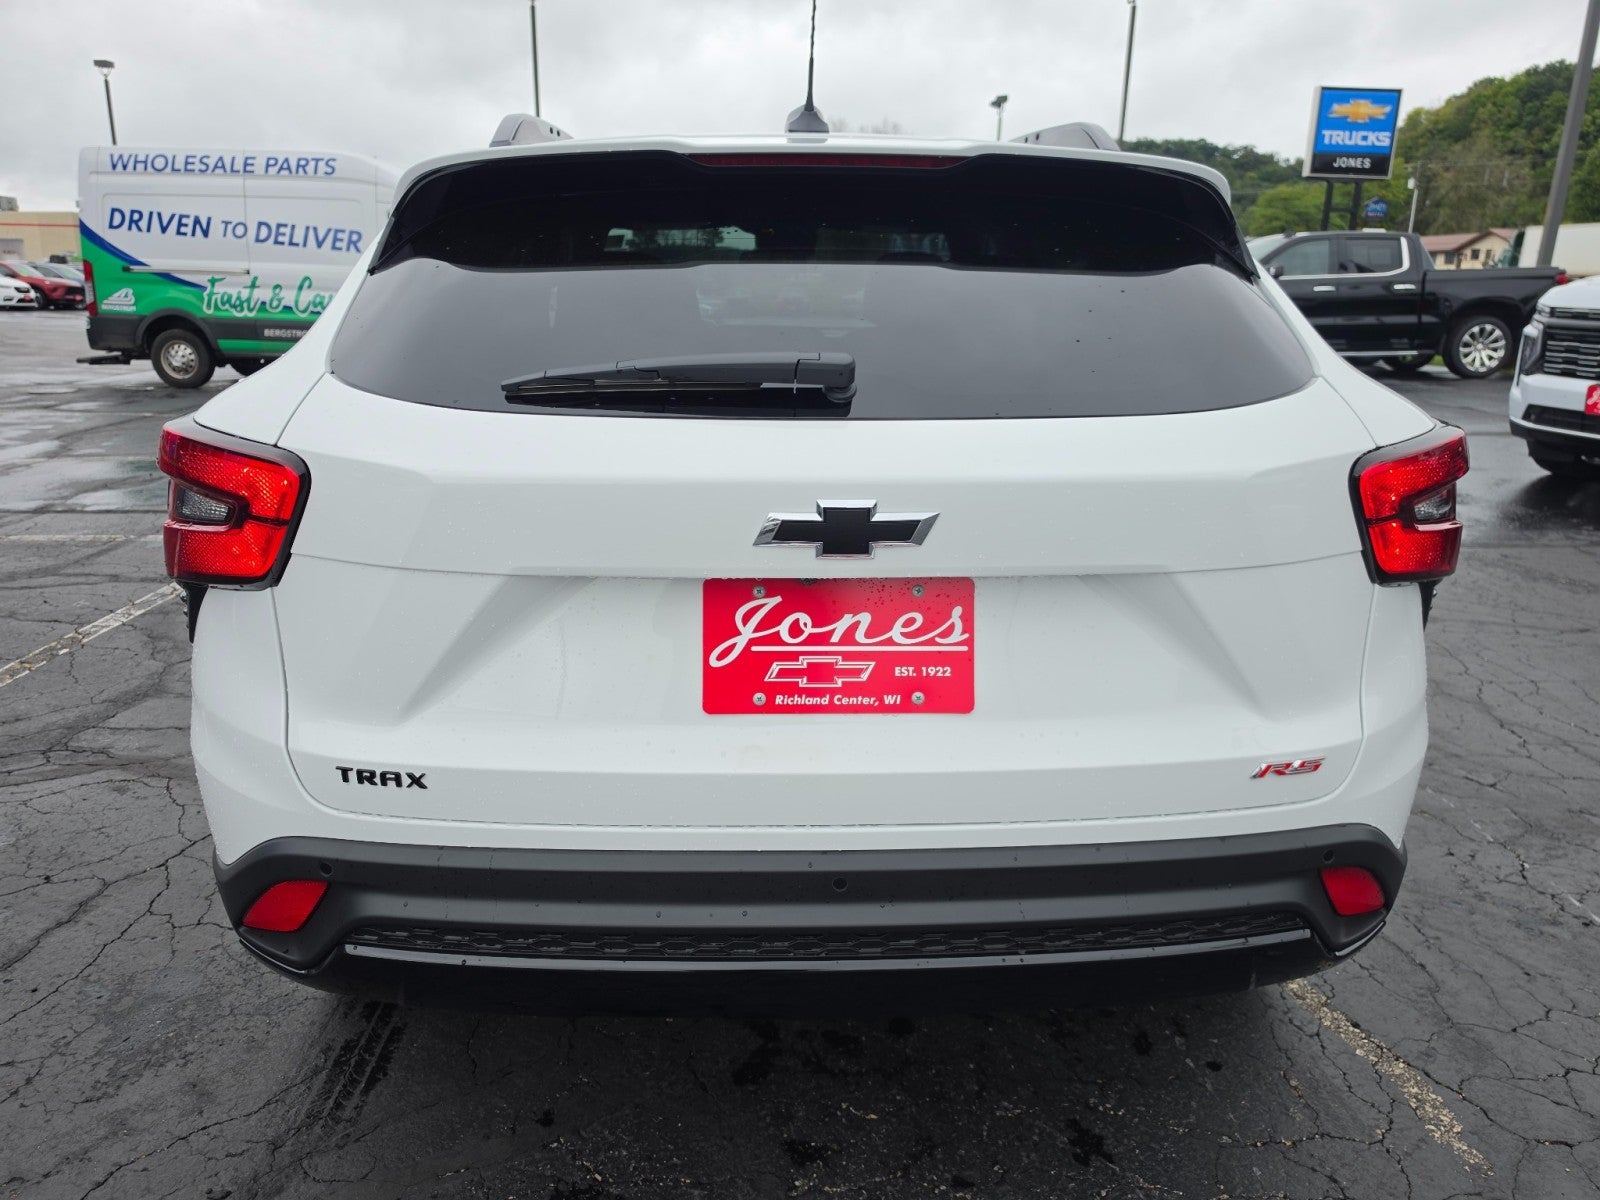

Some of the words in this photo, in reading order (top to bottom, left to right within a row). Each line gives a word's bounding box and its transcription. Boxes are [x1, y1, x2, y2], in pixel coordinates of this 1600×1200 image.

[1322, 129, 1392, 147] TRUCKS
[109, 153, 257, 174] WHOLESALE
[264, 156, 337, 175] PARTS
[1332, 156, 1372, 169] JONES
[108, 207, 212, 239] DRIVEN
[221, 220, 248, 239] TO
[254, 221, 363, 252] DELIVER
[205, 275, 260, 316] Fast
[269, 283, 285, 311] &
[708, 595, 970, 668] Jones
[894, 666, 917, 677] EST.
[921, 666, 952, 677] 1922
[775, 694, 830, 705] Richland
[833, 694, 880, 707] Center,
[883, 694, 901, 705] WI
[335, 765, 429, 790] TRAX
[1250, 757, 1326, 779] RS
